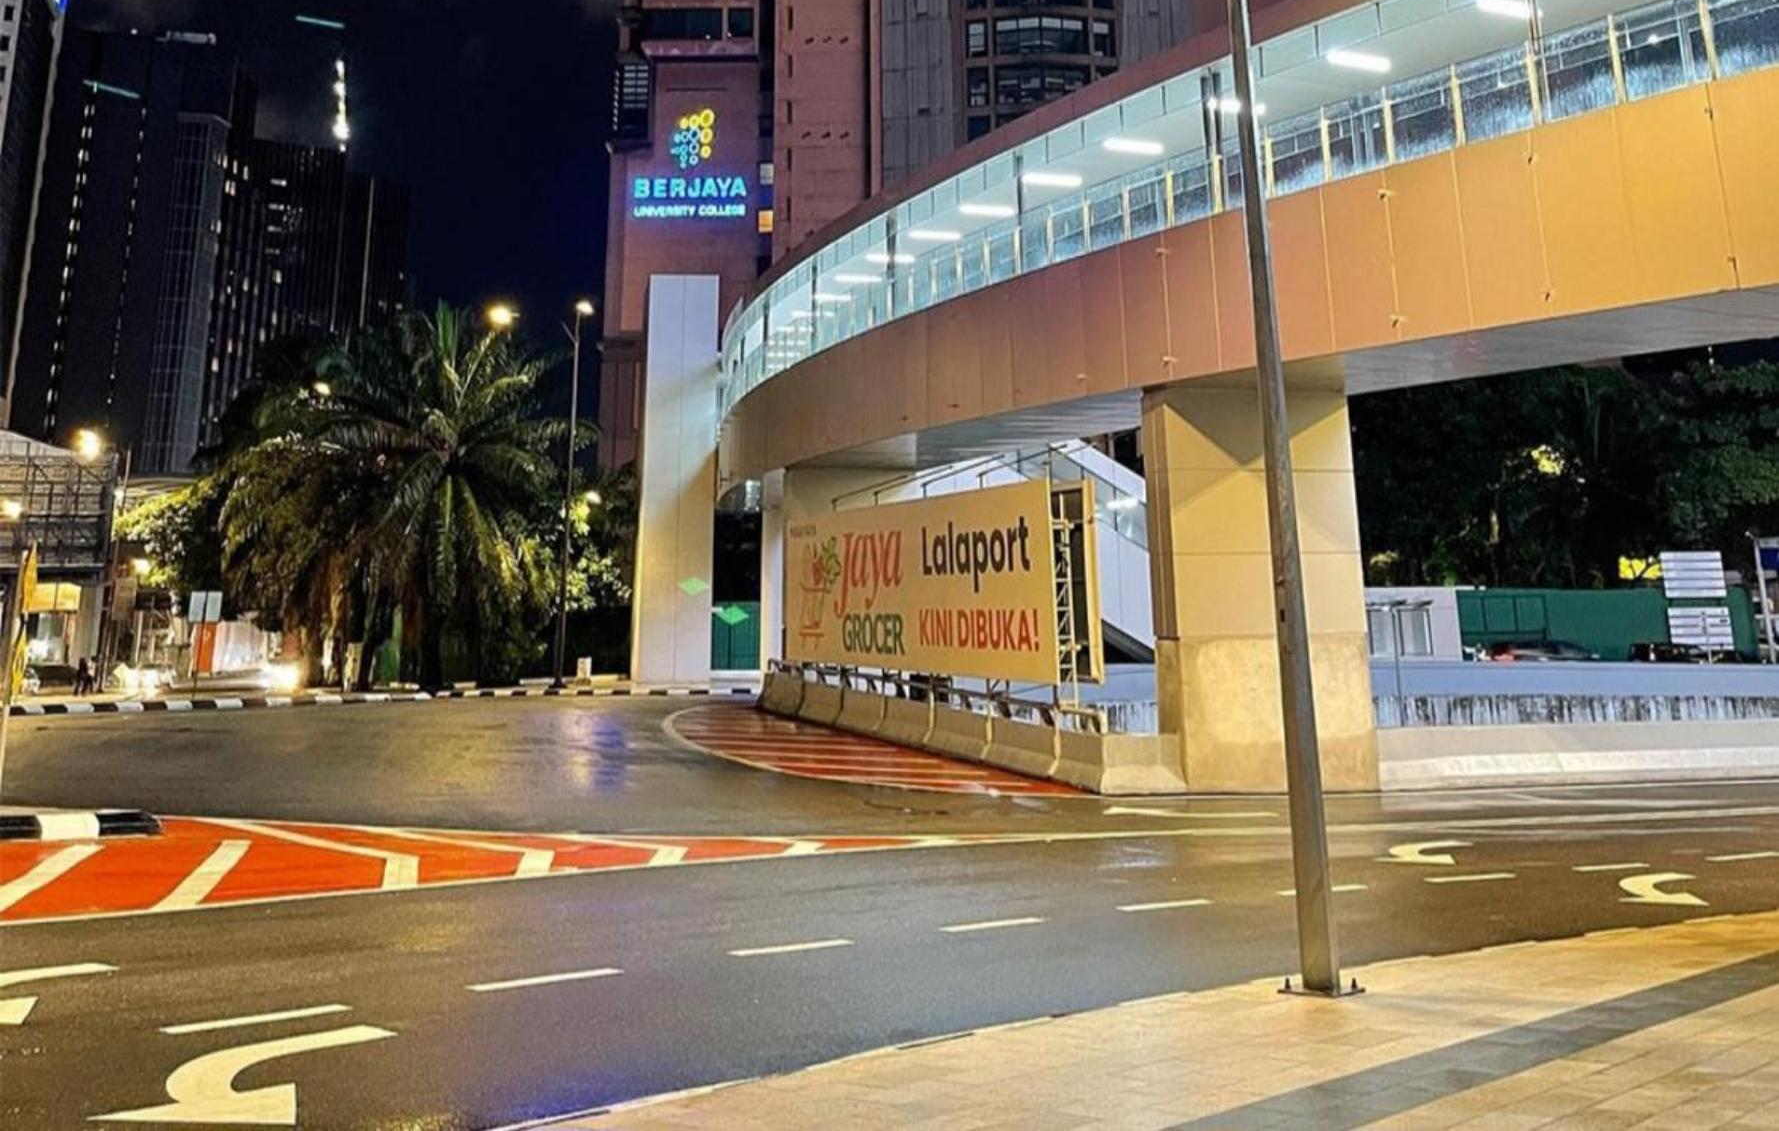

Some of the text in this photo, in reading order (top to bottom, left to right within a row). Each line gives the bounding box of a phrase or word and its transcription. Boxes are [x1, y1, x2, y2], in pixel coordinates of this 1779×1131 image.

[633, 176, 747, 199] BERJAYA
[633, 203, 746, 218] UNIVERSITY COLLEGE
[921, 515, 1031, 594] Lalaport
[842, 613, 906, 656] GROCER
[918, 608, 1040, 653] KINI DIBUKA!
